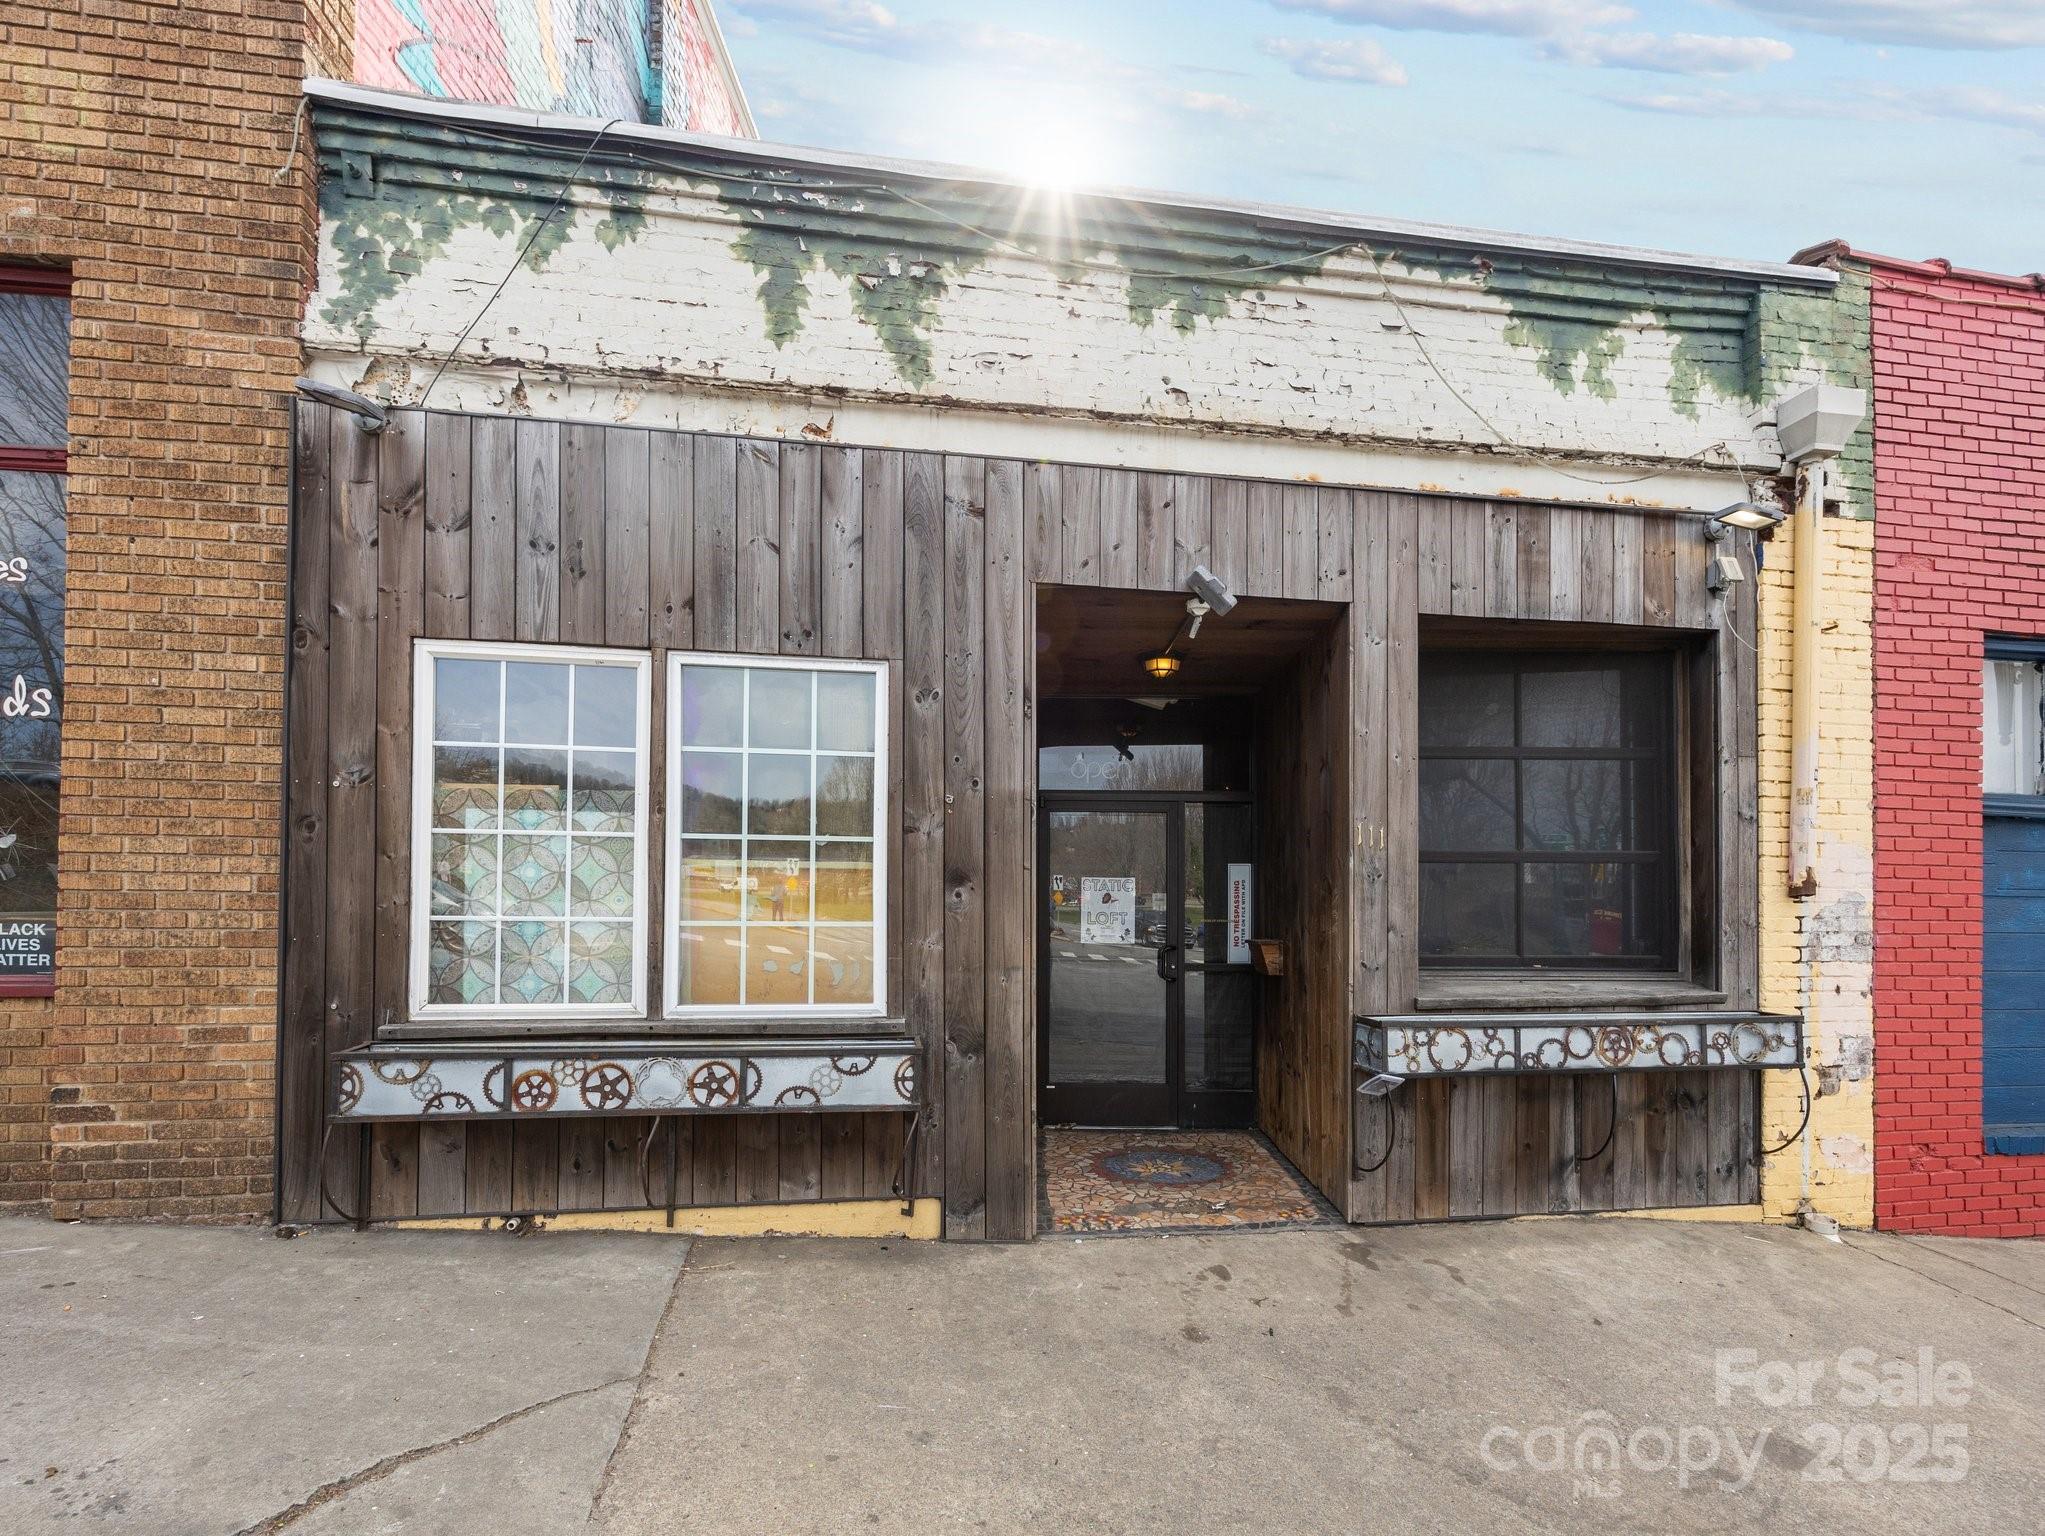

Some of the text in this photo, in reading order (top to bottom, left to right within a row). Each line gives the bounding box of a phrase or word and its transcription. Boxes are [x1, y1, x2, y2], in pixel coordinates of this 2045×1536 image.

[1071, 761, 1133, 783] open
[1082, 878, 1134, 893] STATIC
[1086, 911, 1128, 925] LOFT
[1241, 918, 1246, 928] ON
[0, 938, 41, 951] IVES
[1233, 935, 1240, 948] NO
